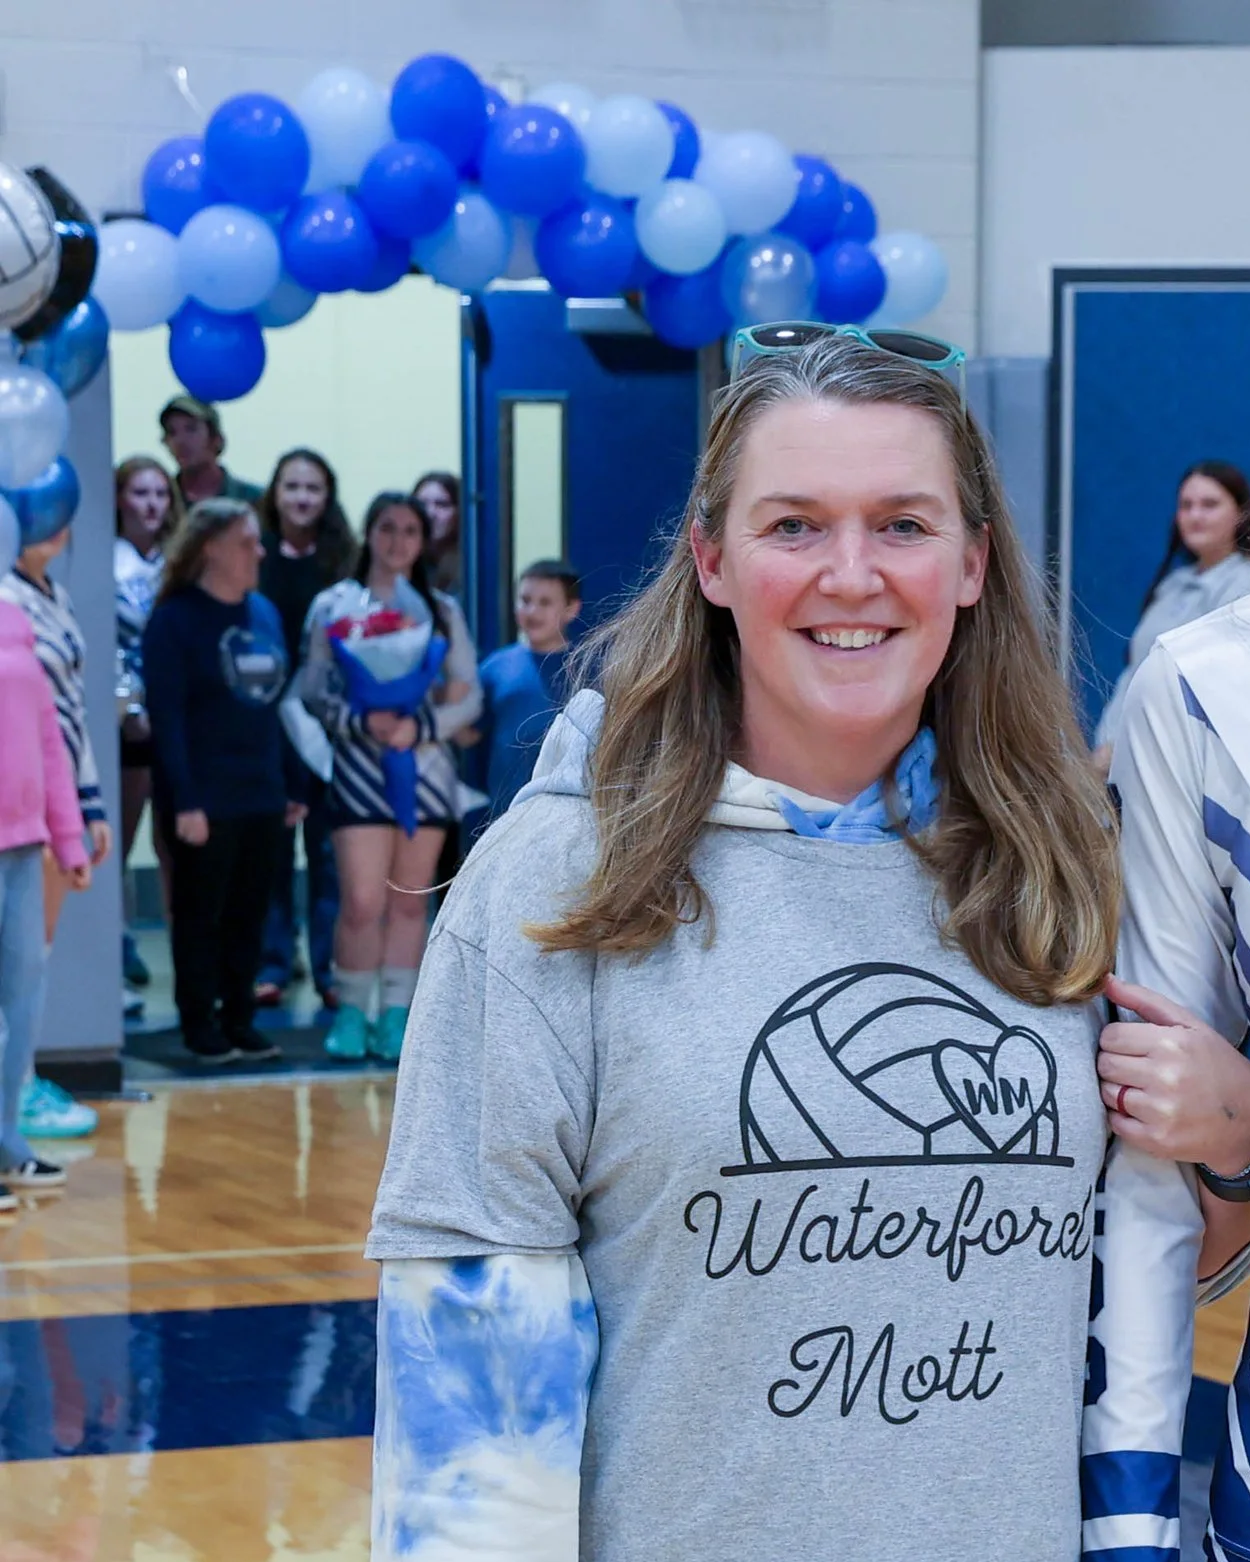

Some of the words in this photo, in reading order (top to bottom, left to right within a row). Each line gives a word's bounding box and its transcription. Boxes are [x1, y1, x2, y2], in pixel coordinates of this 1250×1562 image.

[963, 1077, 1035, 1116] WM
[684, 1175, 1093, 1283] Waterford
[767, 1320, 1004, 1426] Mott
